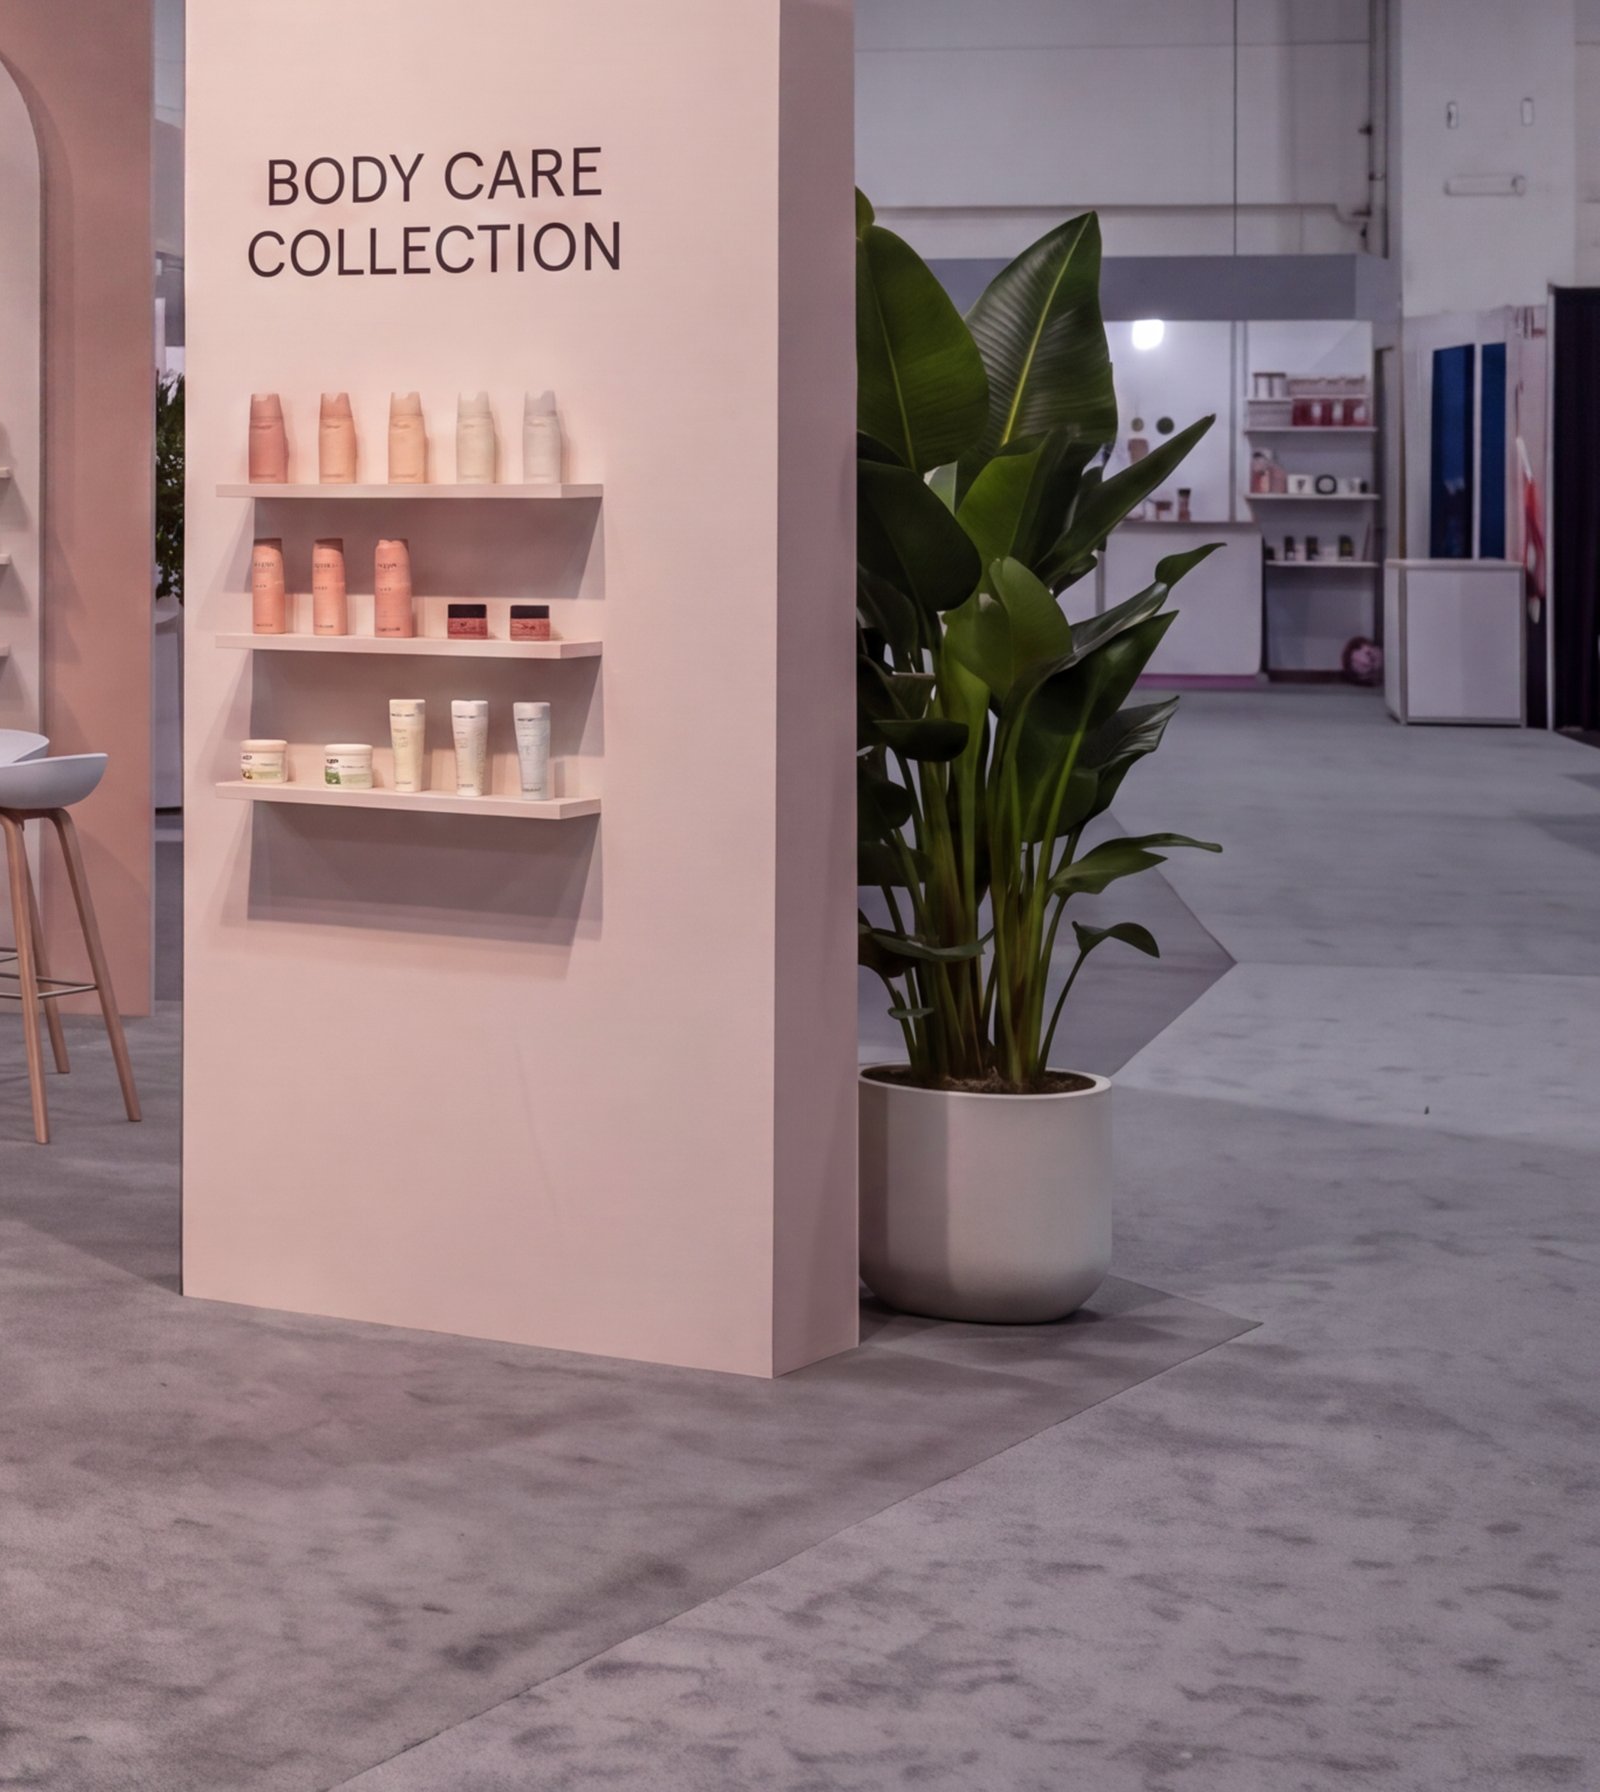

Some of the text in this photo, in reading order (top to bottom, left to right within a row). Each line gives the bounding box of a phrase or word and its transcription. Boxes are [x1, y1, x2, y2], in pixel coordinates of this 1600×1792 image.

[268, 146, 602, 206] BODY CARE
[248, 221, 620, 277] COLLECTION
